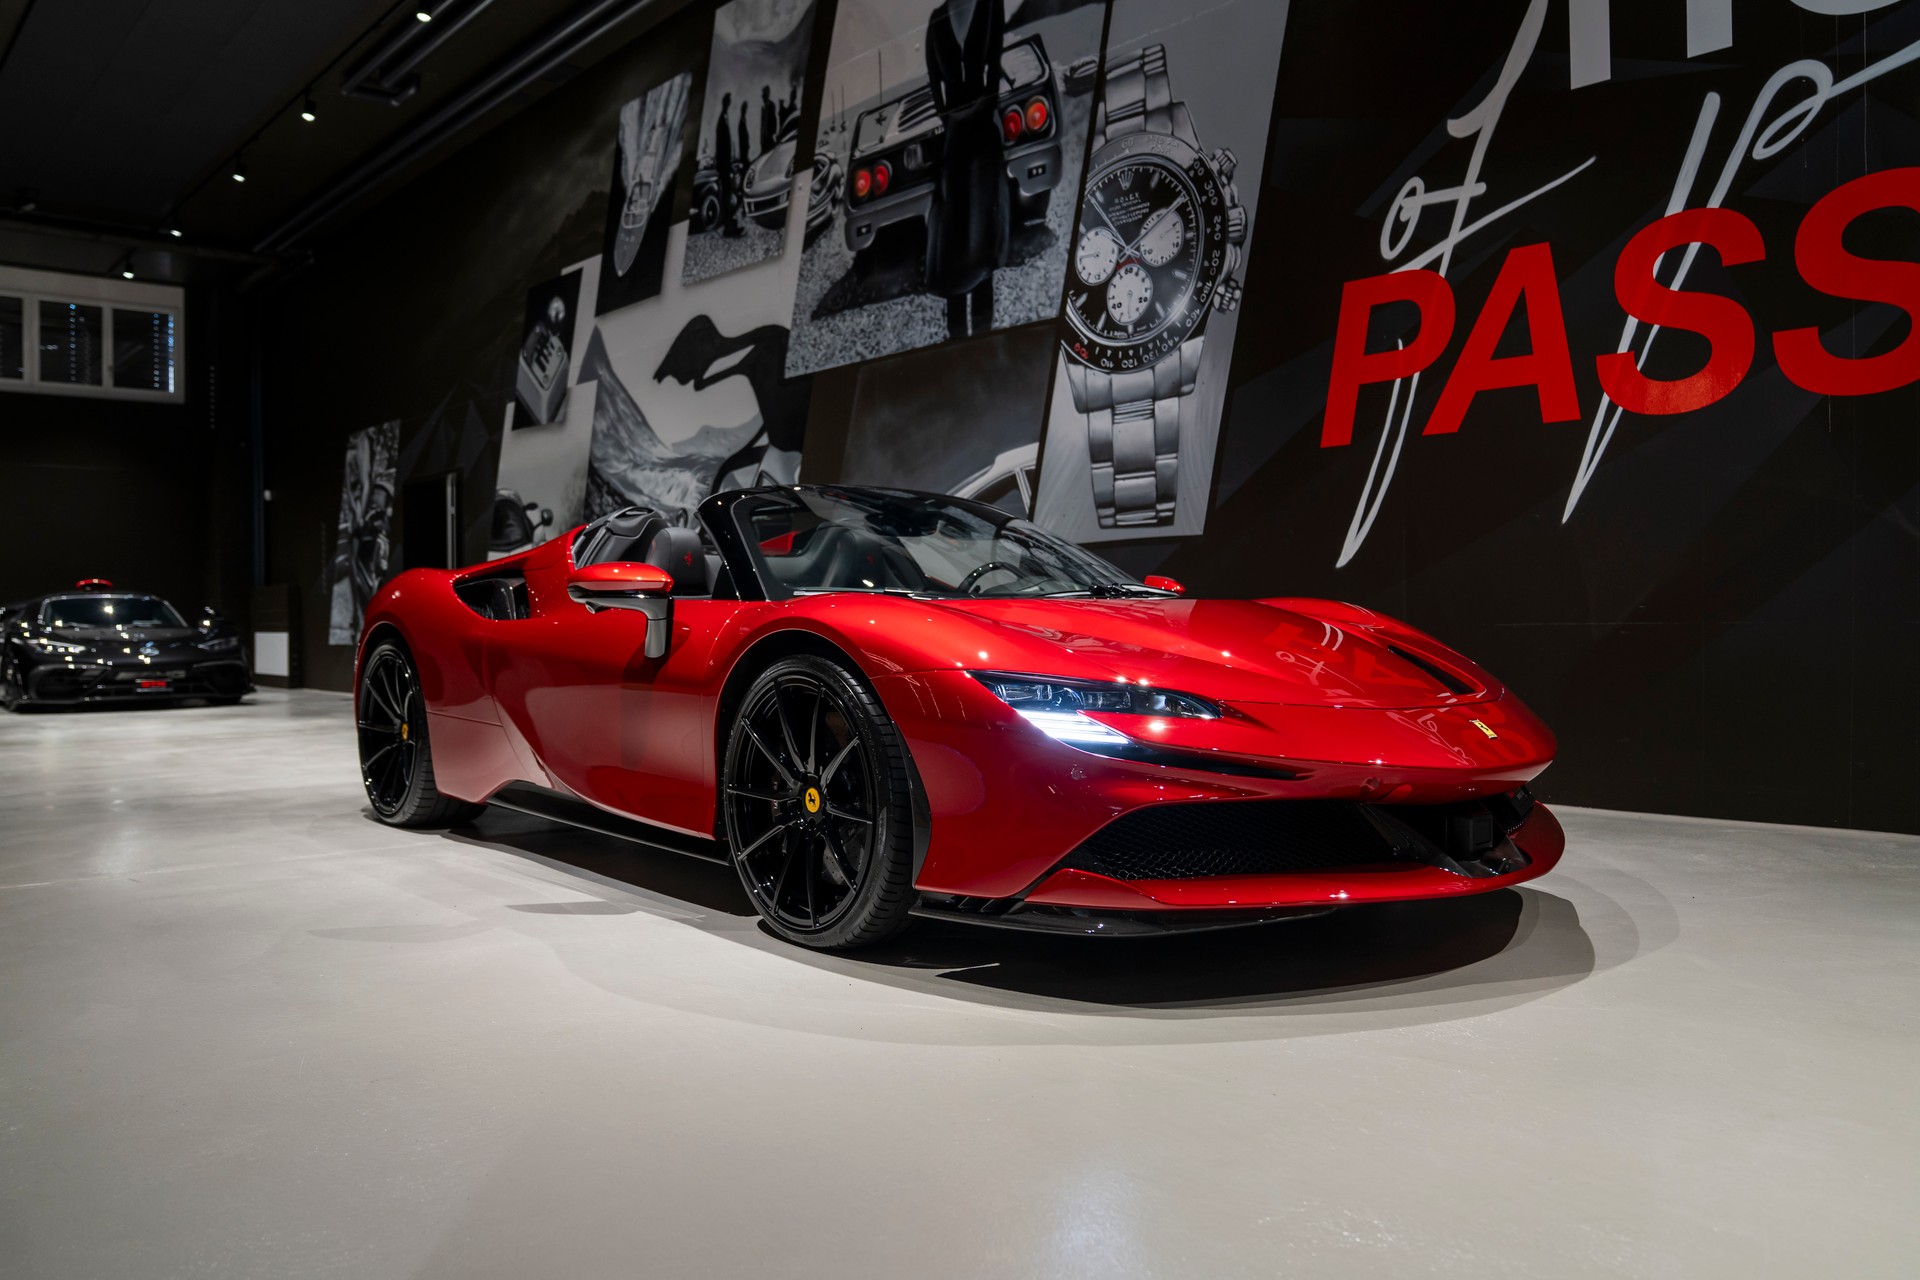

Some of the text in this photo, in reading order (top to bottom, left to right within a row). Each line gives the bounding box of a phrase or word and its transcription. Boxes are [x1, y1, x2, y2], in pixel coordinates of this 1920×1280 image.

[1203, 179, 1219, 206] 300
[1212, 214, 1222, 241] 240
[1209, 250, 1221, 276] 200
[1320, 167, 1920, 449] PASS
